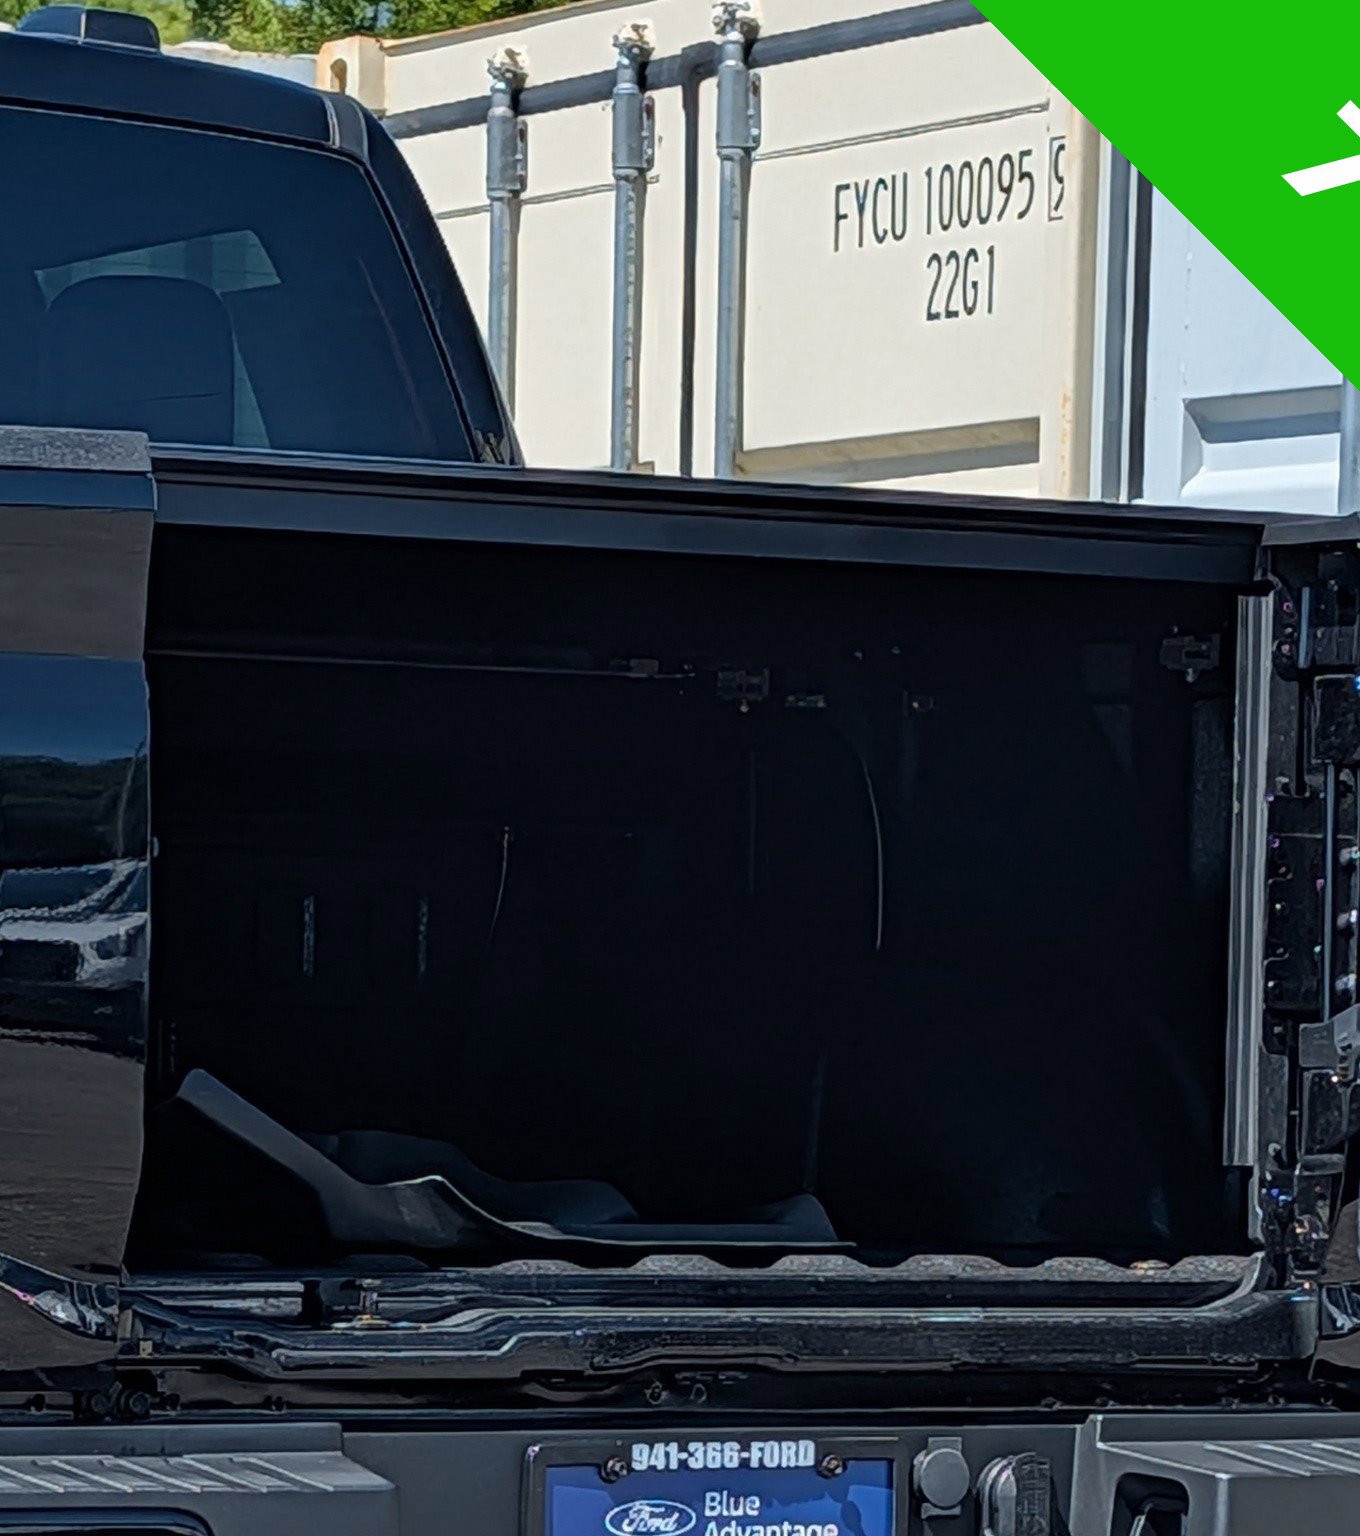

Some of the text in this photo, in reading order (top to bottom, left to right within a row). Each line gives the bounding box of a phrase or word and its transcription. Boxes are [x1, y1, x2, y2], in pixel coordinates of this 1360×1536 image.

[834, 172, 908, 252] FYCU
[924, 149, 1035, 235] 100095
[926, 245, 994, 321] 22G1
[631, 1439, 816, 1471] 941-366-FORD
[704, 1490, 761, 1517] Blue
